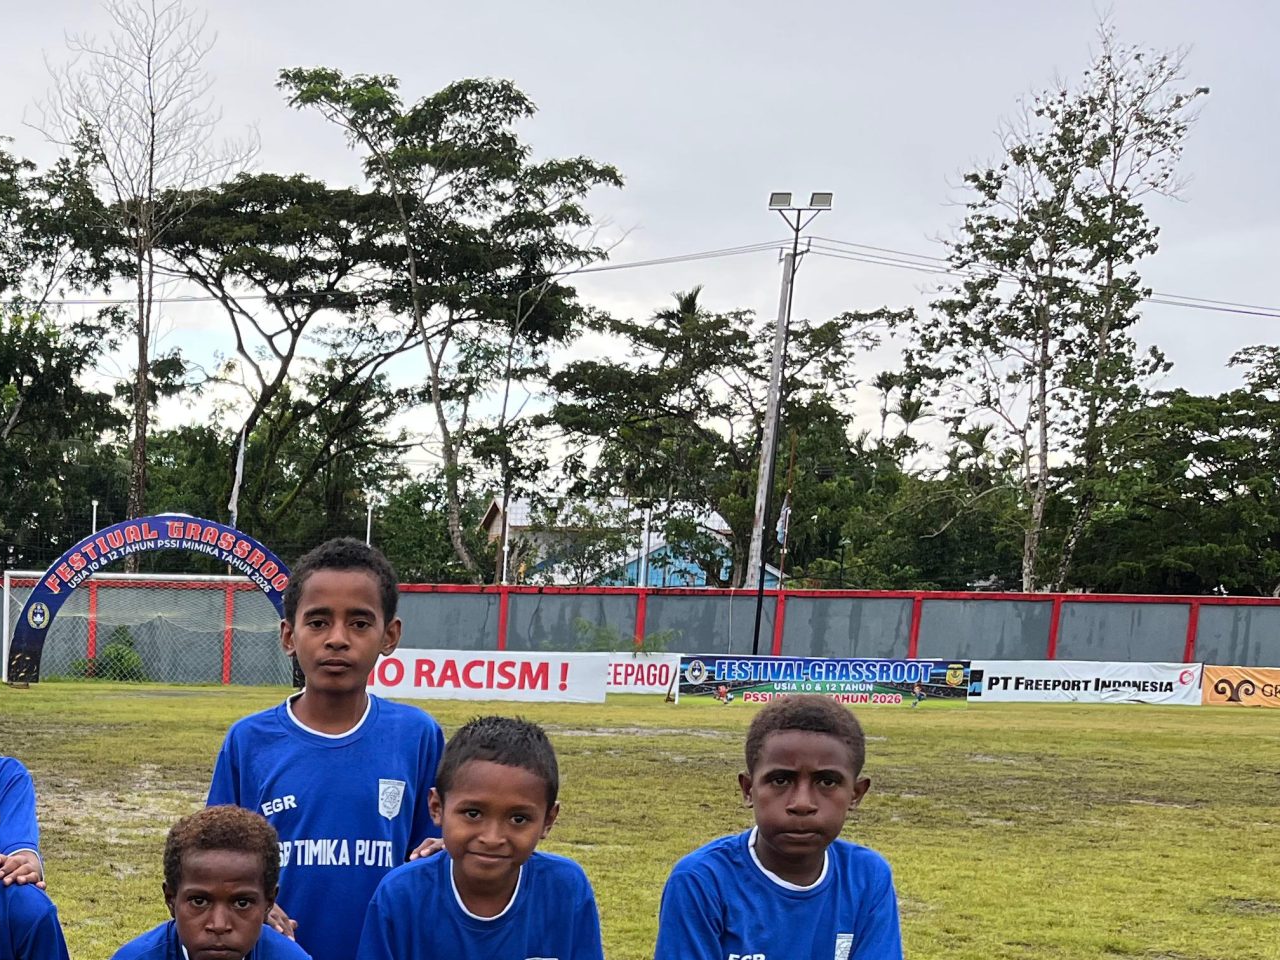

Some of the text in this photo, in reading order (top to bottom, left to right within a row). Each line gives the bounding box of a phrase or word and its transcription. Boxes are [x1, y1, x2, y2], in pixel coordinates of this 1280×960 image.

[45, 521, 289, 594] FESTIVAL GRASSROO
[67, 571, 90, 589] USIA
[107, 549, 119, 561] 12
[119, 540, 155, 557] TAHUN
[157, 539, 180, 548] PSSI
[182, 541, 220, 558] MIMIKA
[221, 551, 254, 577] TAHUN
[413, 658, 549, 691] RACISM
[715, 661, 935, 683] FESTIVAL GRASSROOT
[774, 683, 874, 691] USIA 10 & 12 TAHUN
[988, 676, 1012, 691] PT
[872, 694, 902, 704] 2026
[261, 794, 297, 816] EGR
[294, 839, 350, 866] TIMIKA
